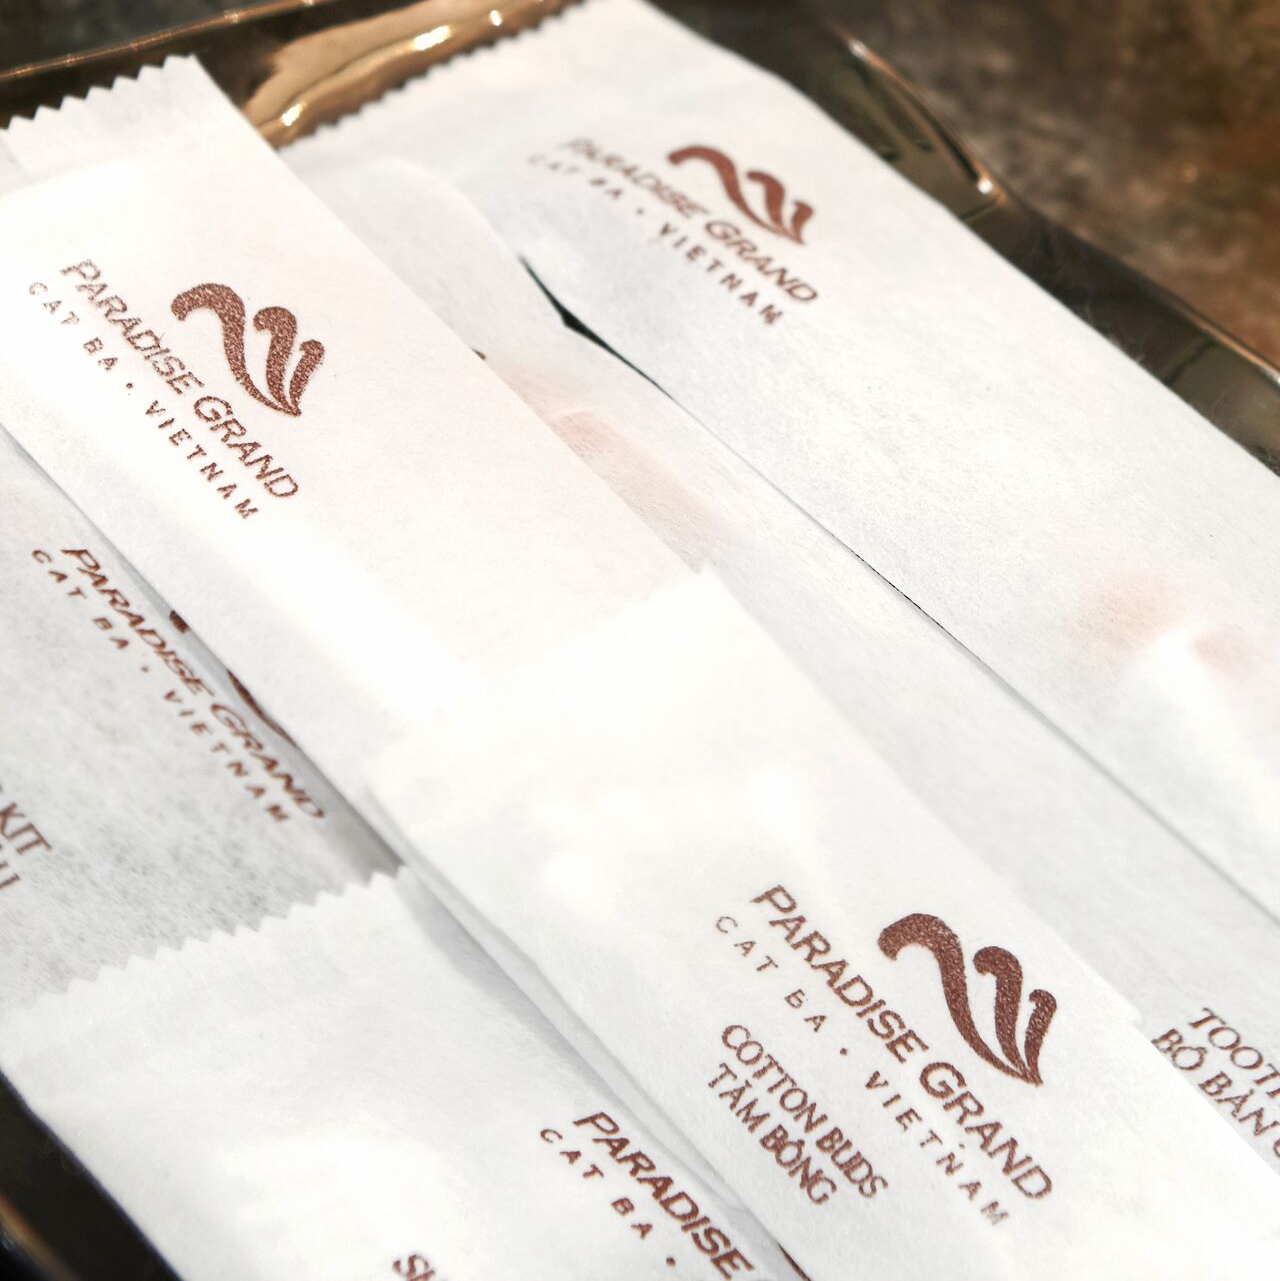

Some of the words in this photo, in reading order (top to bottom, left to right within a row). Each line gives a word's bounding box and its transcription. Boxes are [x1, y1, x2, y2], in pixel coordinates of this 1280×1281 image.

[60, 259, 205, 396] PARADISE
[193, 395, 298, 498] GRAND
[659, 222, 783, 325] VIETNAM
[705, 220, 818, 302] GRAND
[29, 281, 80, 325] CAT
[83, 336, 118, 371] BA
[145, 400, 258, 519] VIETNAM
[31, 549, 86, 598] CAT
[93, 617, 129, 650] BA
[164, 690, 289, 822] VIETNAM
[61, 549, 214, 697] PARADISE
[210, 703, 325, 818] GRAND
[715, 916, 778, 972] CAT
[784, 989, 827, 1032] BA
[865, 1070, 1009, 1225] VIETNAM
[721, 1023, 828, 1133] COTTON
[815, 1127, 888, 1199] BUDS
[750, 885, 929, 1064] PARADISE
[919, 1061, 1053, 1200] GRAND
[540, 1128, 604, 1179] CAT
[611, 1197, 654, 1240] BA
[572, 1111, 754, 1280] PARADISE
